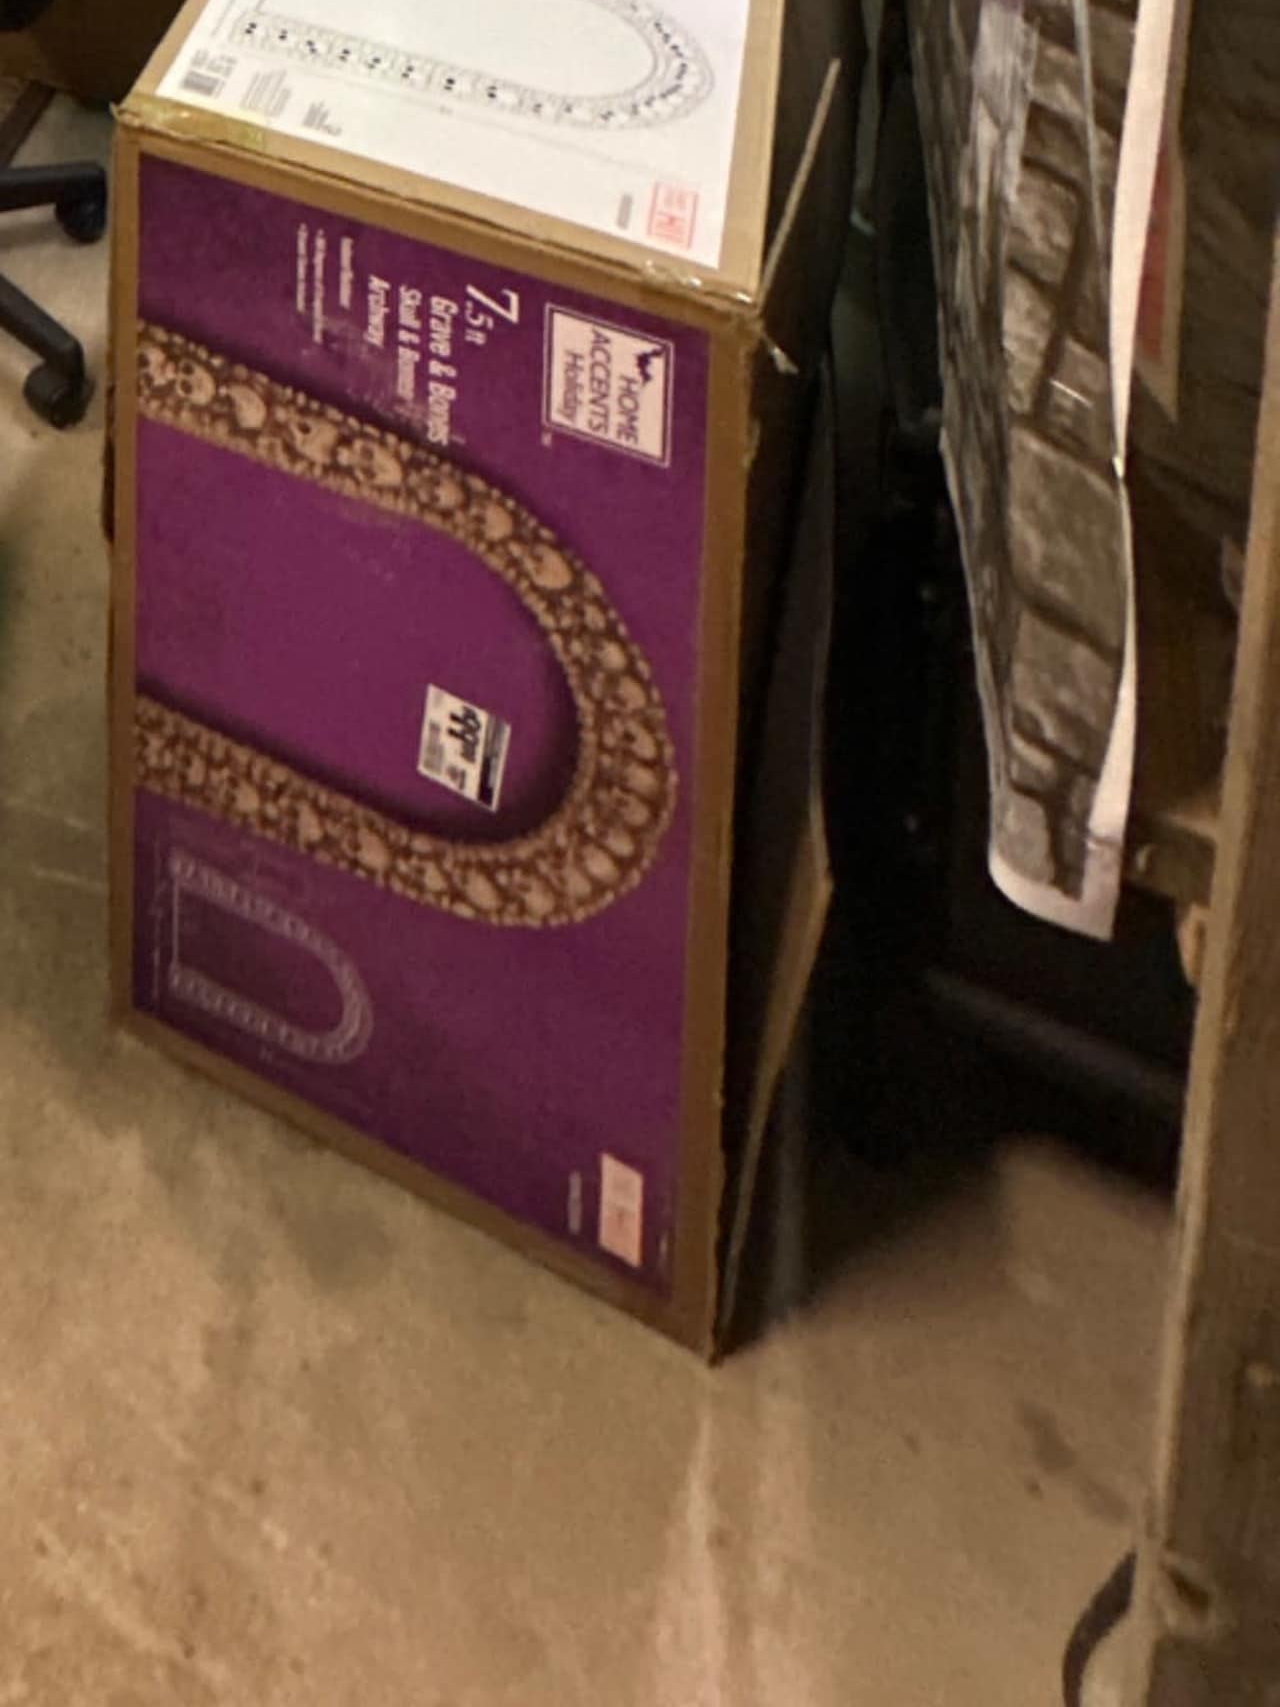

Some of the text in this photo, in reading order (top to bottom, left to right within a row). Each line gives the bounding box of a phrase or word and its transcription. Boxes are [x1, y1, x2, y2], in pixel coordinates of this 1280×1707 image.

[364, 273, 391, 349] Archway
[398, 284, 422, 330] Skull
[426, 295, 459, 446] Grave & Bones
[557, 349, 584, 423] Holiday
[587, 328, 611, 435] ACCENTS
[615, 374, 639, 445] HOME
